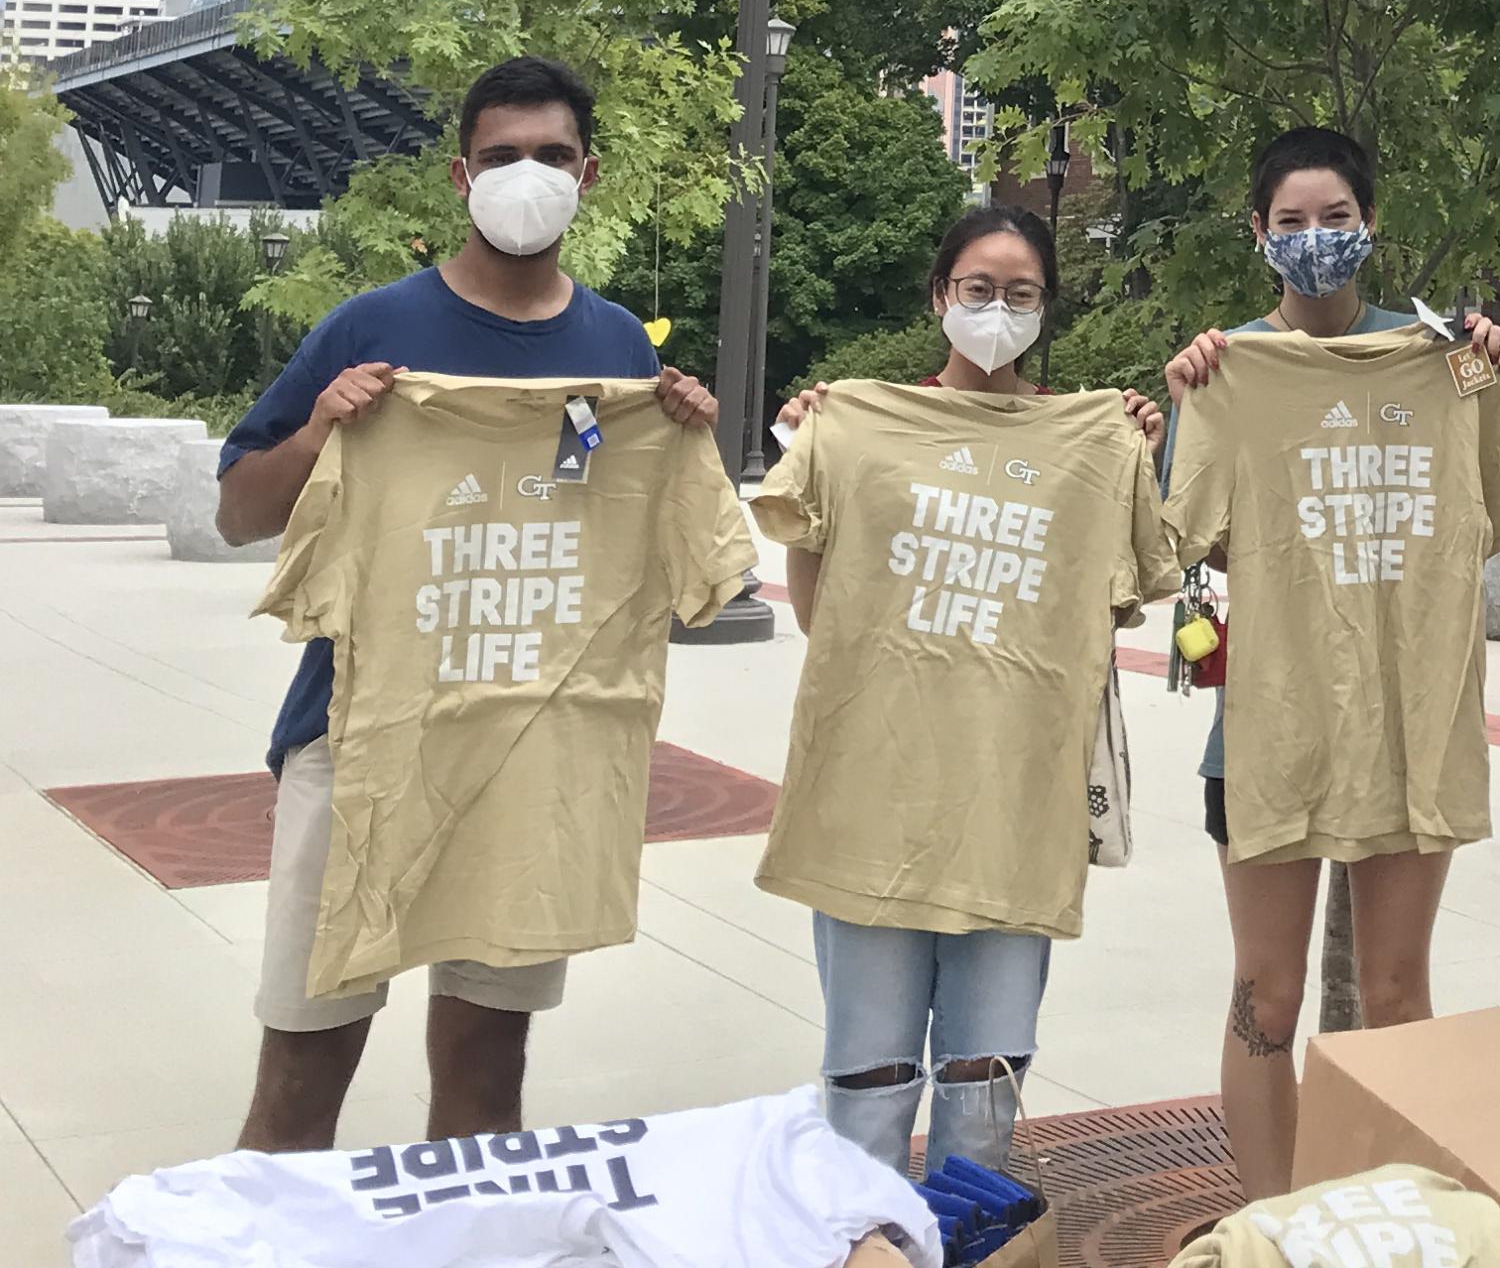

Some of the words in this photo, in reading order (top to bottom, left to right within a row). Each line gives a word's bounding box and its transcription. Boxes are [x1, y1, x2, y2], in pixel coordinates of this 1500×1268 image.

[1460, 358, 1484, 378] GO
[1320, 418, 1358, 428] adidas
[1380, 403, 1414, 426] GT
[939, 459, 979, 476] adidas
[1004, 459, 1041, 485] GT
[1300, 444, 1433, 490] THREE
[446, 492, 488, 506] adidas
[517, 475, 556, 501] GT
[910, 482, 1055, 552] THREE
[1297, 492, 1437, 538] STRIPE
[422, 521, 581, 576] THREE
[888, 532, 1047, 603] STRIPE
[1332, 539, 1405, 585] LIFE
[416, 575, 584, 633] STRIPE
[907, 586, 1004, 645] LIFE
[438, 632, 542, 682] LIFE
